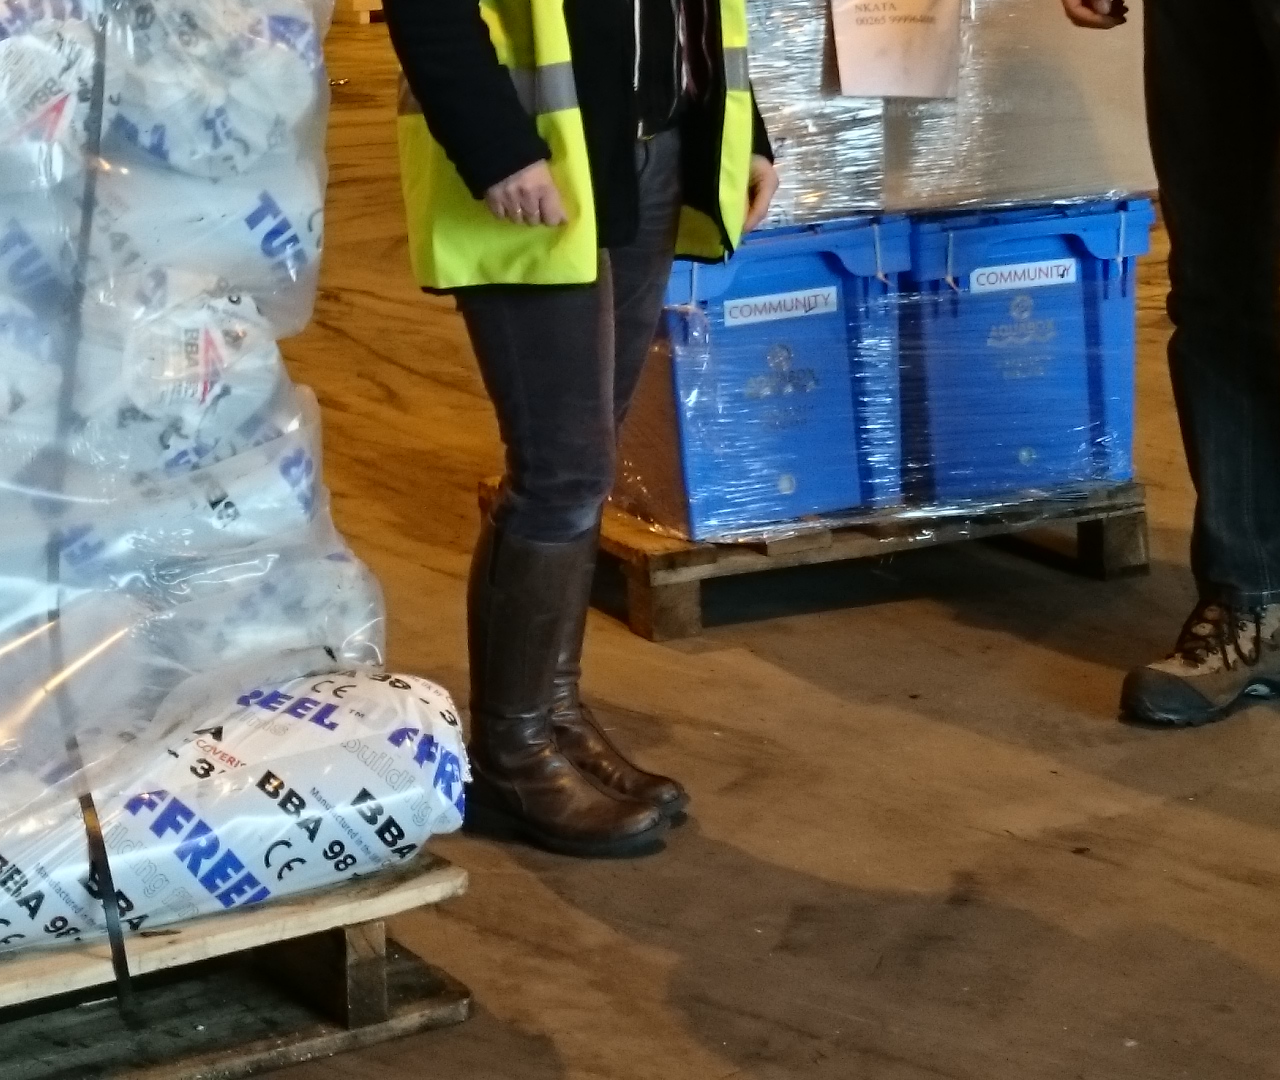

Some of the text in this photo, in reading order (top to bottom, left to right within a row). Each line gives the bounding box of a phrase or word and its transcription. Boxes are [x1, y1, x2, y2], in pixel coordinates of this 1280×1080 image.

[854, 3, 897, 14] NKATA
[976, 264, 1072, 287] COMMUNITY
[728, 293, 831, 319] COMMUNITY
[255, 769, 357, 871] BBA 98
[349, 787, 419, 859] BBA
